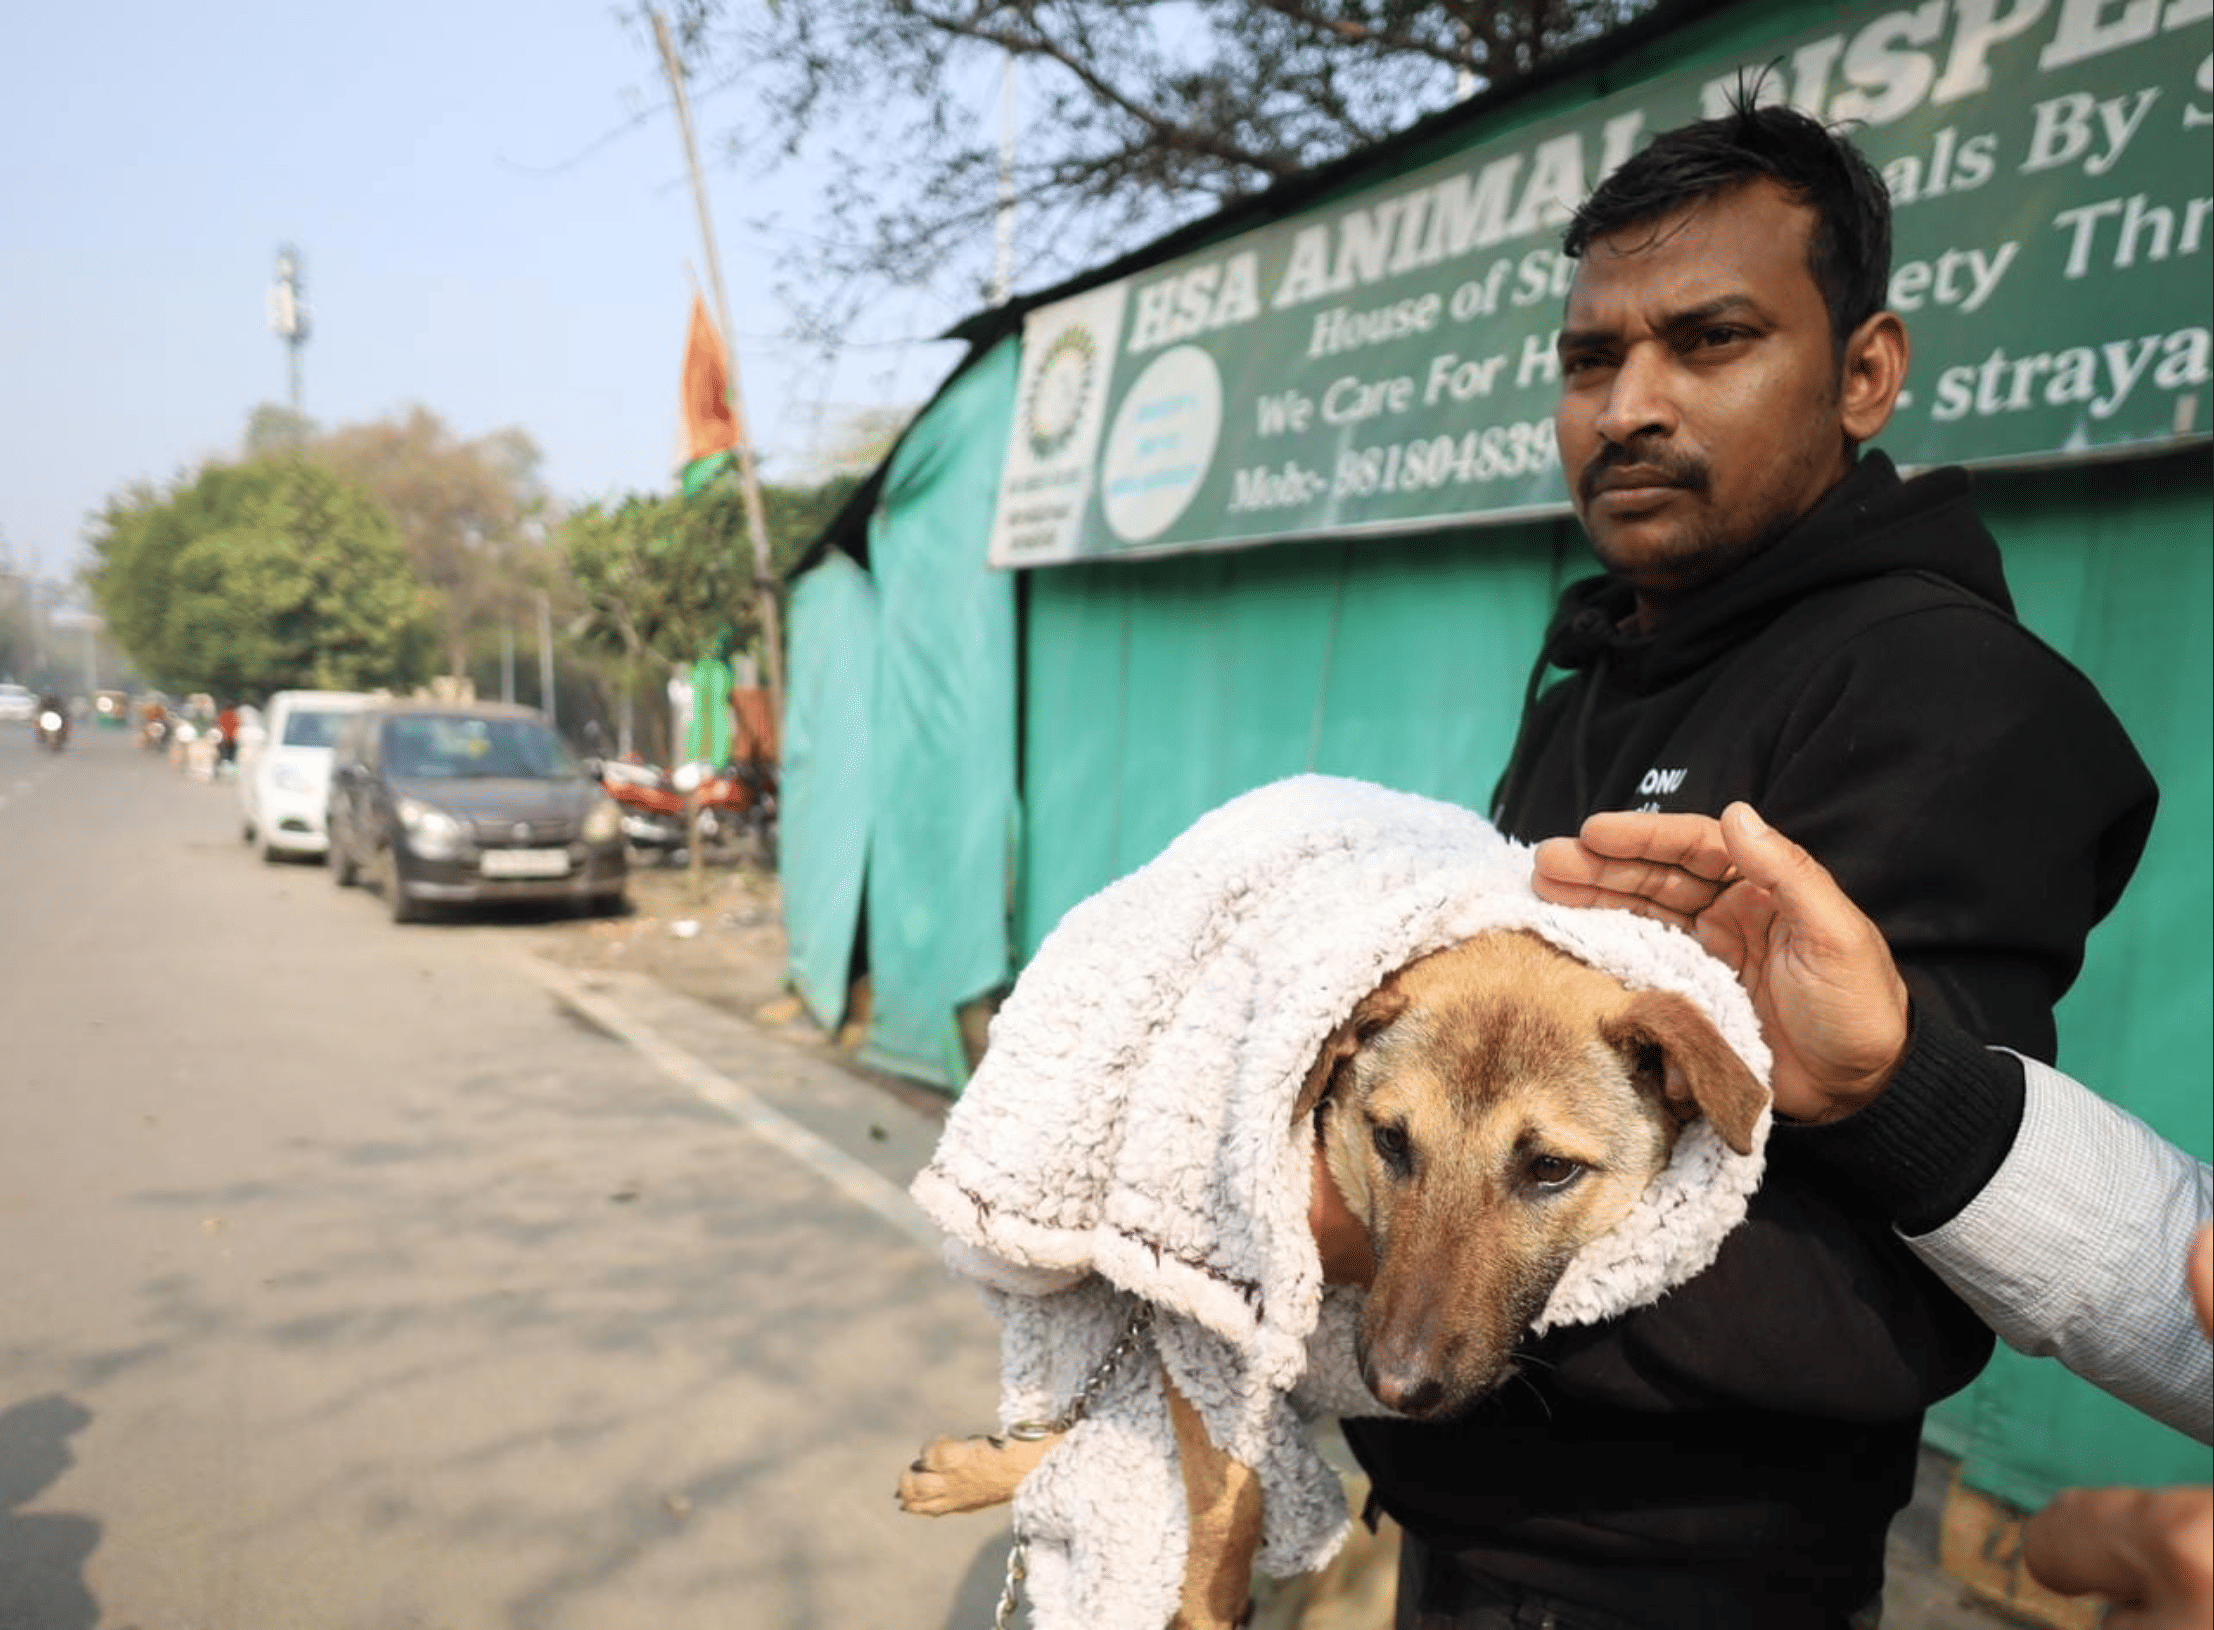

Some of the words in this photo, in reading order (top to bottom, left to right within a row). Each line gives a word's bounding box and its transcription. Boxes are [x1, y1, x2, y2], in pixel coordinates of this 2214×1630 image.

[1307, 291, 1442, 359] House
[1451, 257, 1512, 322] of
[2018, 86, 2164, 177] By
[1127, 250, 1259, 354] HSA
[1257, 388, 1315, 438] We
[1320, 375, 1415, 425] Care
[1423, 352, 1508, 406] For
[1635, 767, 1688, 796] ONU
